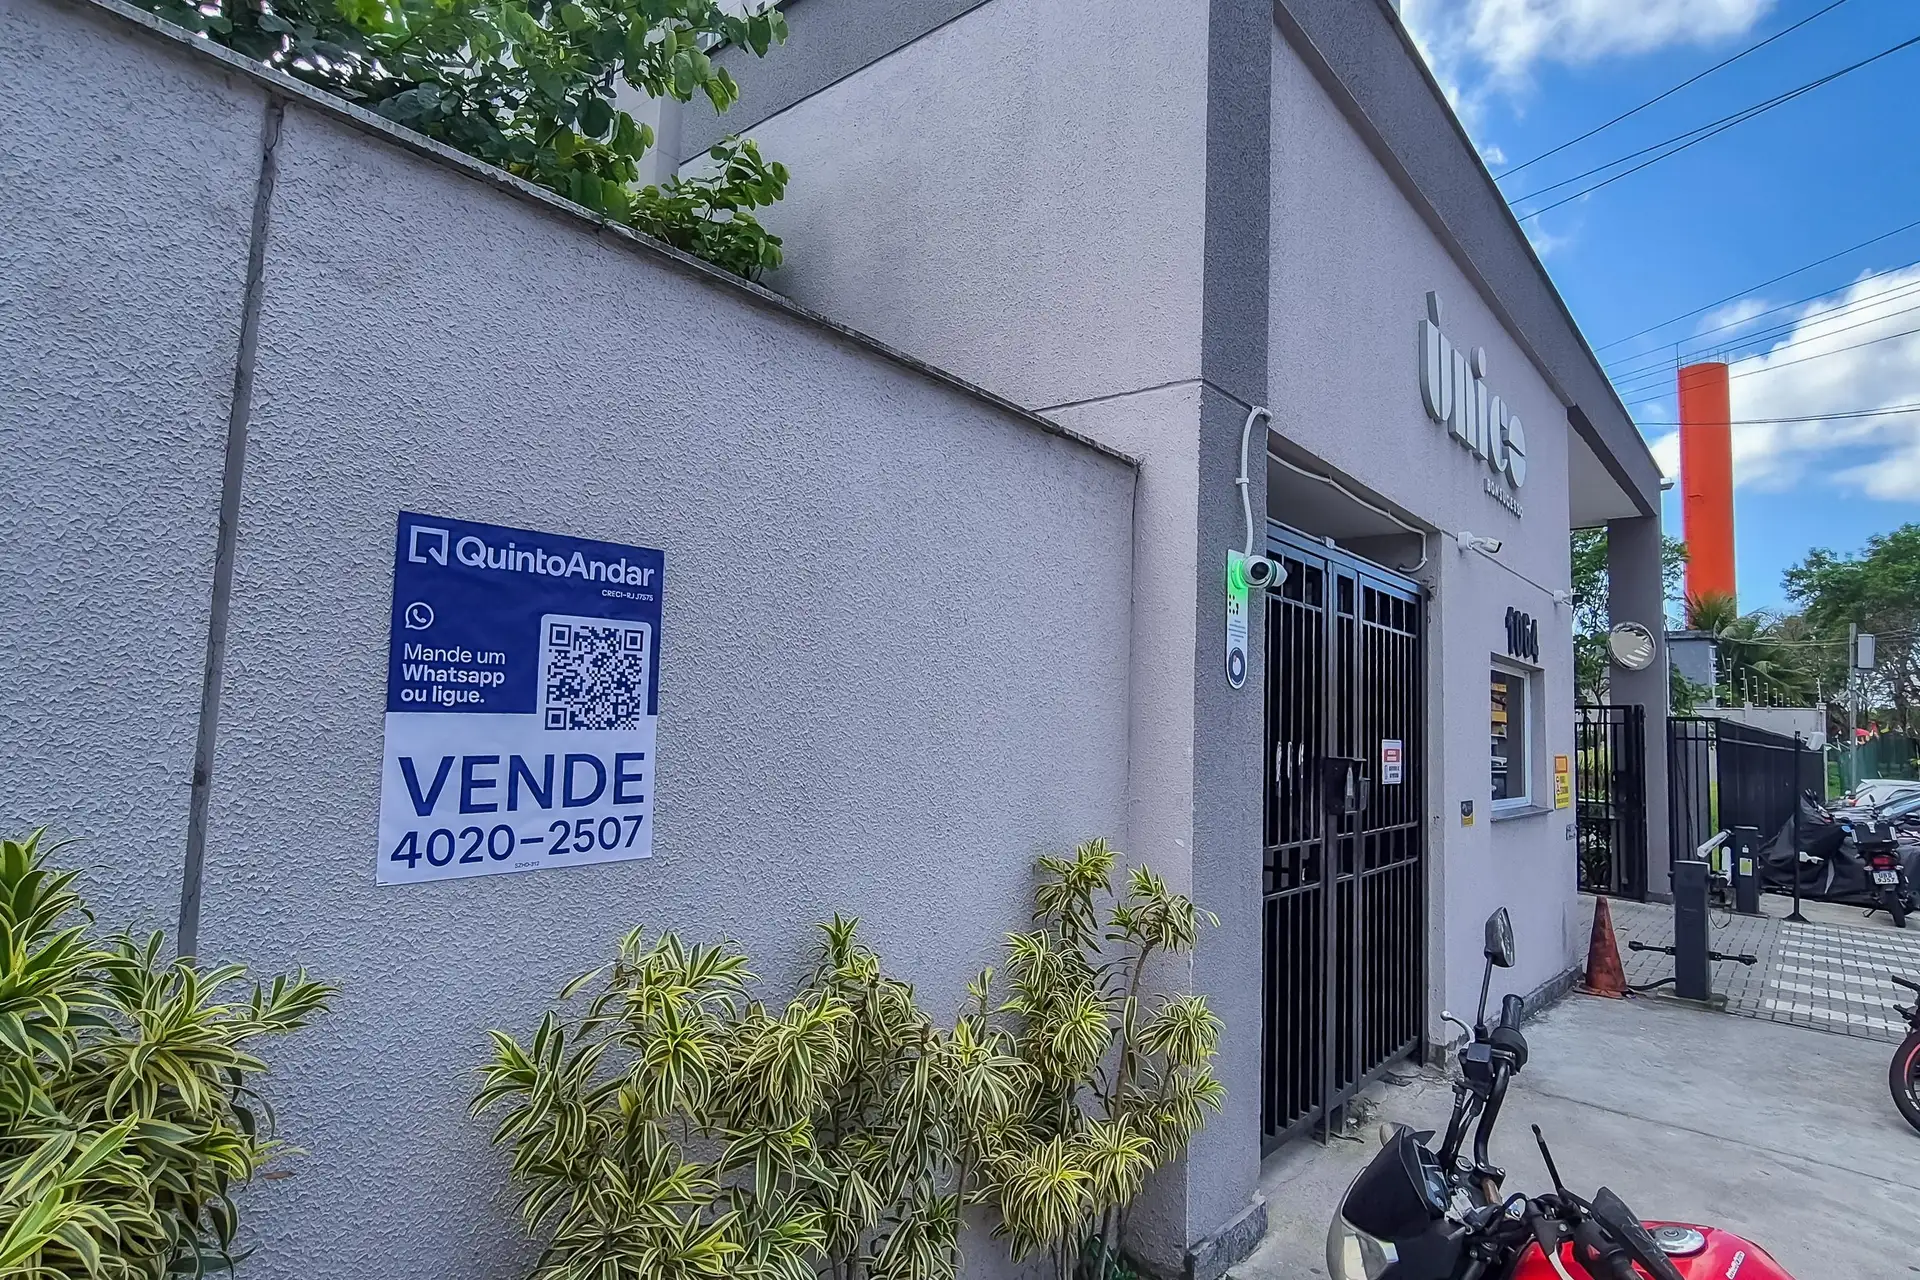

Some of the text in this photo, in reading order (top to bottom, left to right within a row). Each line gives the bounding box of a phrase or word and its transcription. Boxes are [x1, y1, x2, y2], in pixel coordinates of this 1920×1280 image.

[455, 535, 655, 587] QuintoAndar
[601, 589, 635, 599] CRECI-RJ
[1504, 605, 1540, 665] 1064
[403, 642, 506, 664] Mande um
[402, 663, 506, 687] Whatsapp
[400, 685, 485, 706] ou ligue.
[397, 752, 645, 818] VENDE
